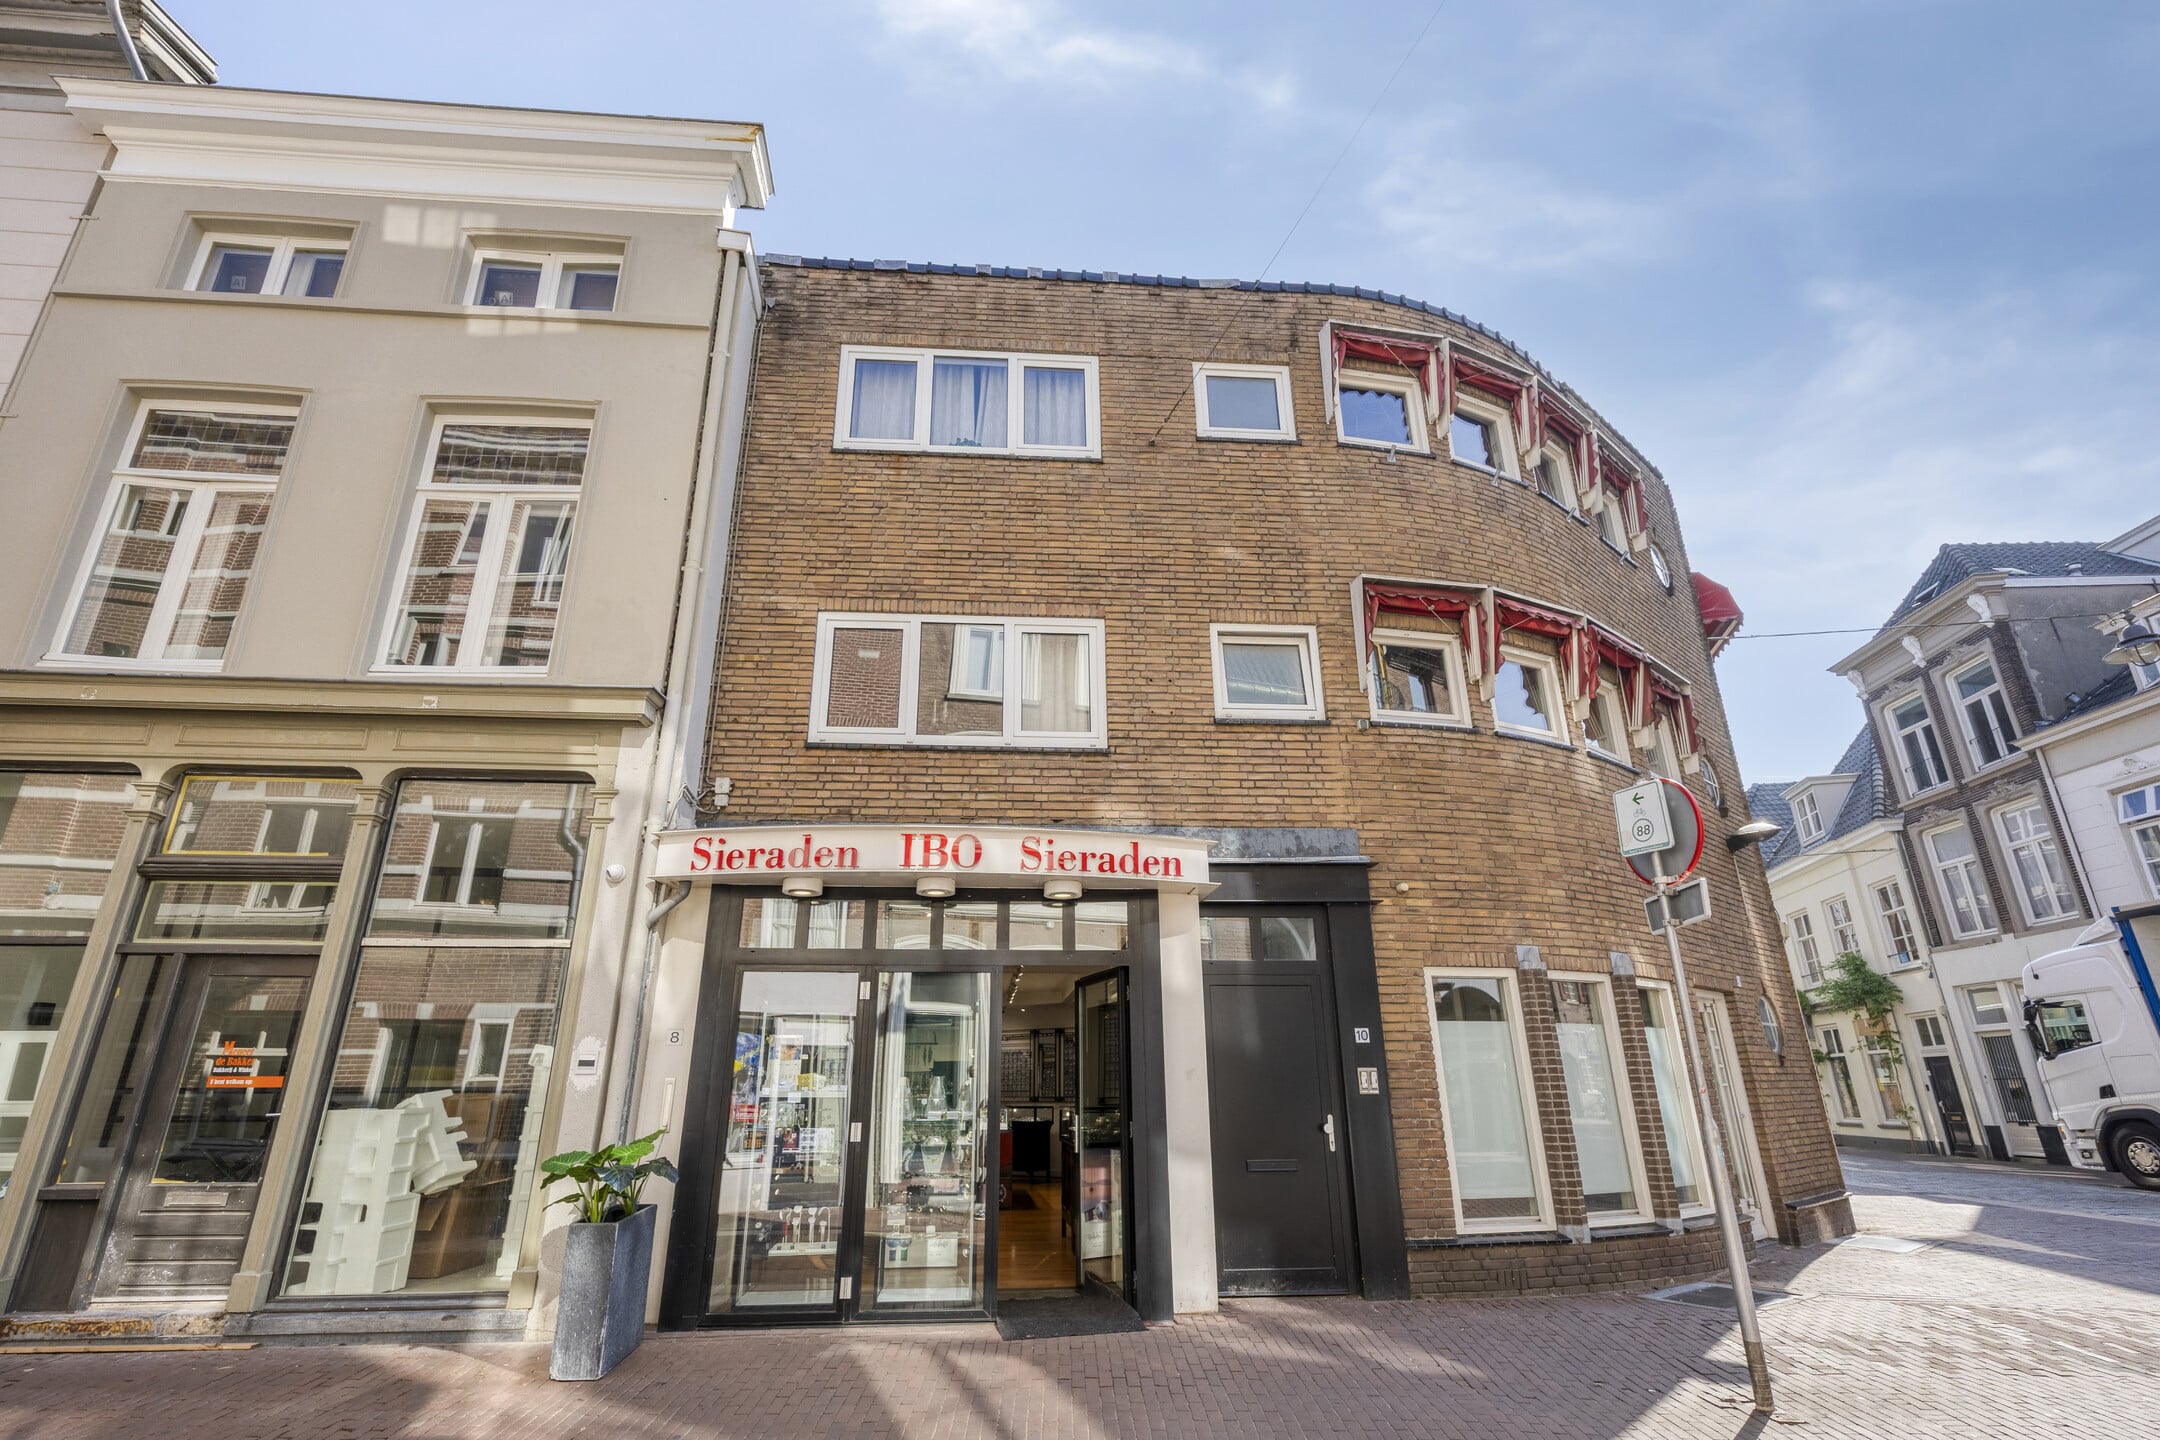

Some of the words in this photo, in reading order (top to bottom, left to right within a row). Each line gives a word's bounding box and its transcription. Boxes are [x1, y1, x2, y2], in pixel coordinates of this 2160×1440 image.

[1636, 824, 1651, 837] 88
[690, 834, 859, 872] Sieraden
[900, 833, 983, 869] IBO
[1020, 836, 1184, 878] Sieraden
[670, 1031, 680, 1043] 8
[1355, 1030, 1369, 1041] 10
